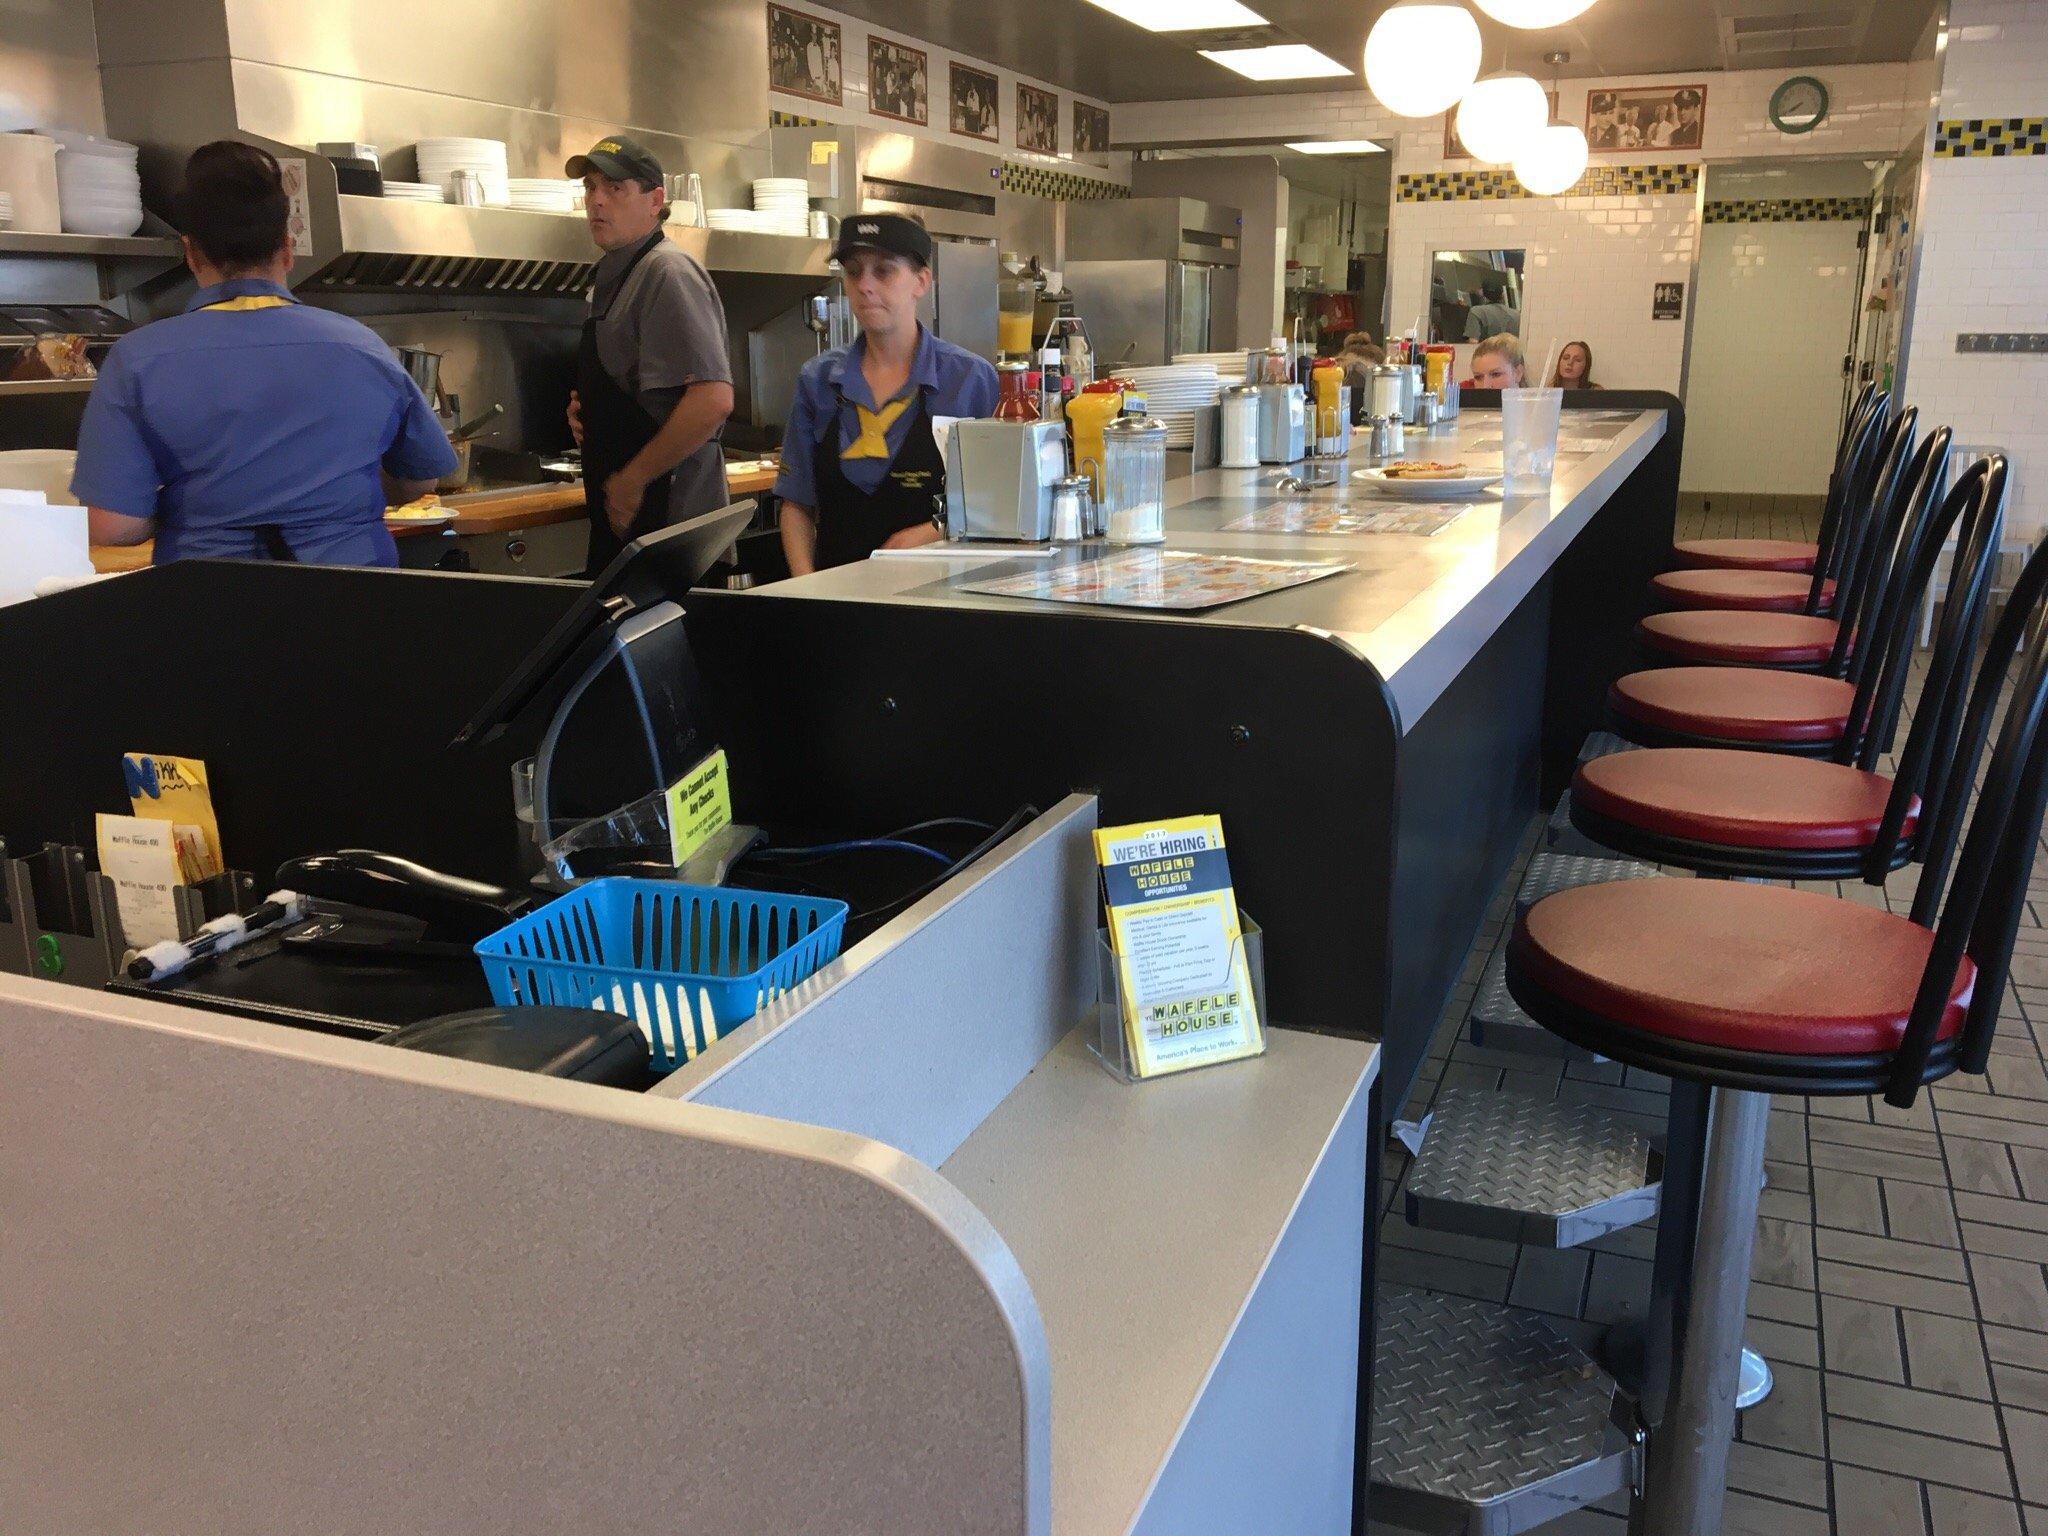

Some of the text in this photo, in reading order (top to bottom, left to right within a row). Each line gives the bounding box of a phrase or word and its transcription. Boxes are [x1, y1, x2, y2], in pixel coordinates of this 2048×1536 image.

[1145, 831, 1167, 839] 2017
[1112, 835, 1206, 862] WE'RE HIRING
[1130, 857, 1194, 876] WAFFLE
[1138, 871, 1191, 888] HOUSE
[1144, 883, 1188, 897] OPPORTUNITIES
[1154, 993, 1239, 1019] WAFFLE
[1156, 1047, 1188, 1061] America's
[1190, 1043, 1209, 1055] Place
[1217, 1039, 1238, 1049] Work.
